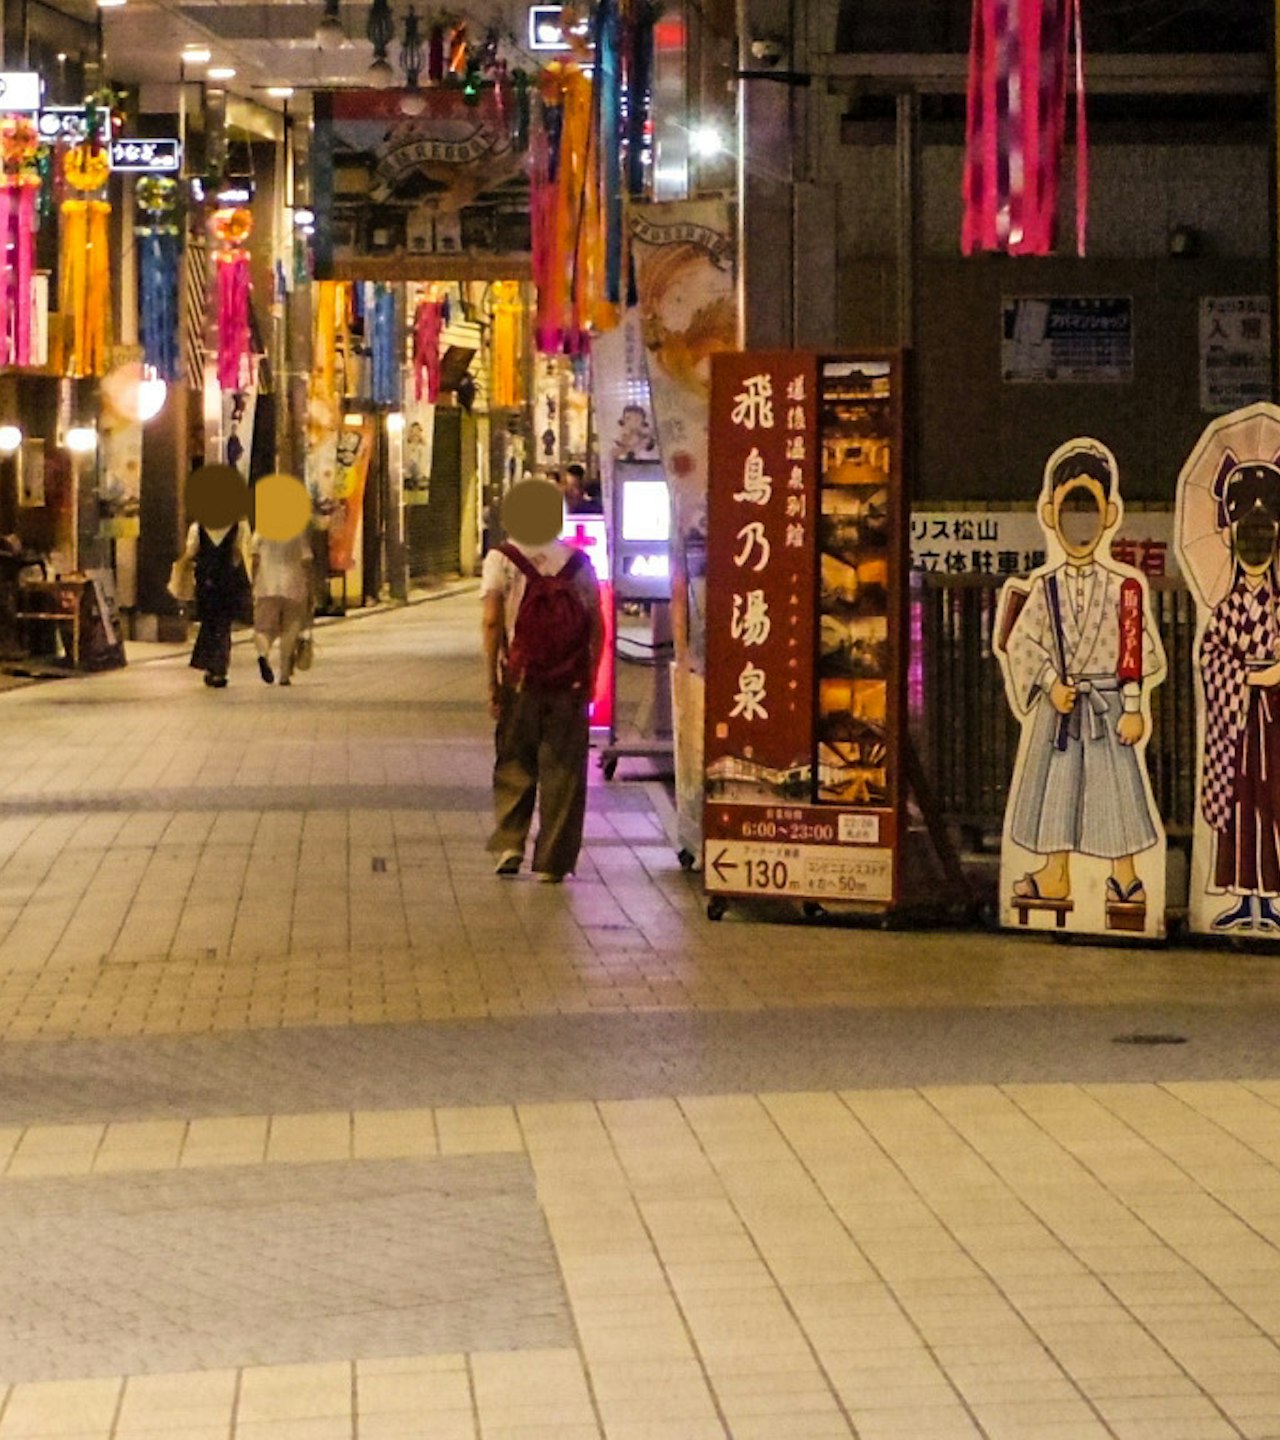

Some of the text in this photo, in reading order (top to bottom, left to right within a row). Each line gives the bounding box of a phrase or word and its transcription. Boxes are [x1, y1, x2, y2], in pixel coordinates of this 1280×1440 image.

[729, 373, 775, 721] 飛鳥乃湯泉
[784, 374, 808, 549] 道後温泉別館
